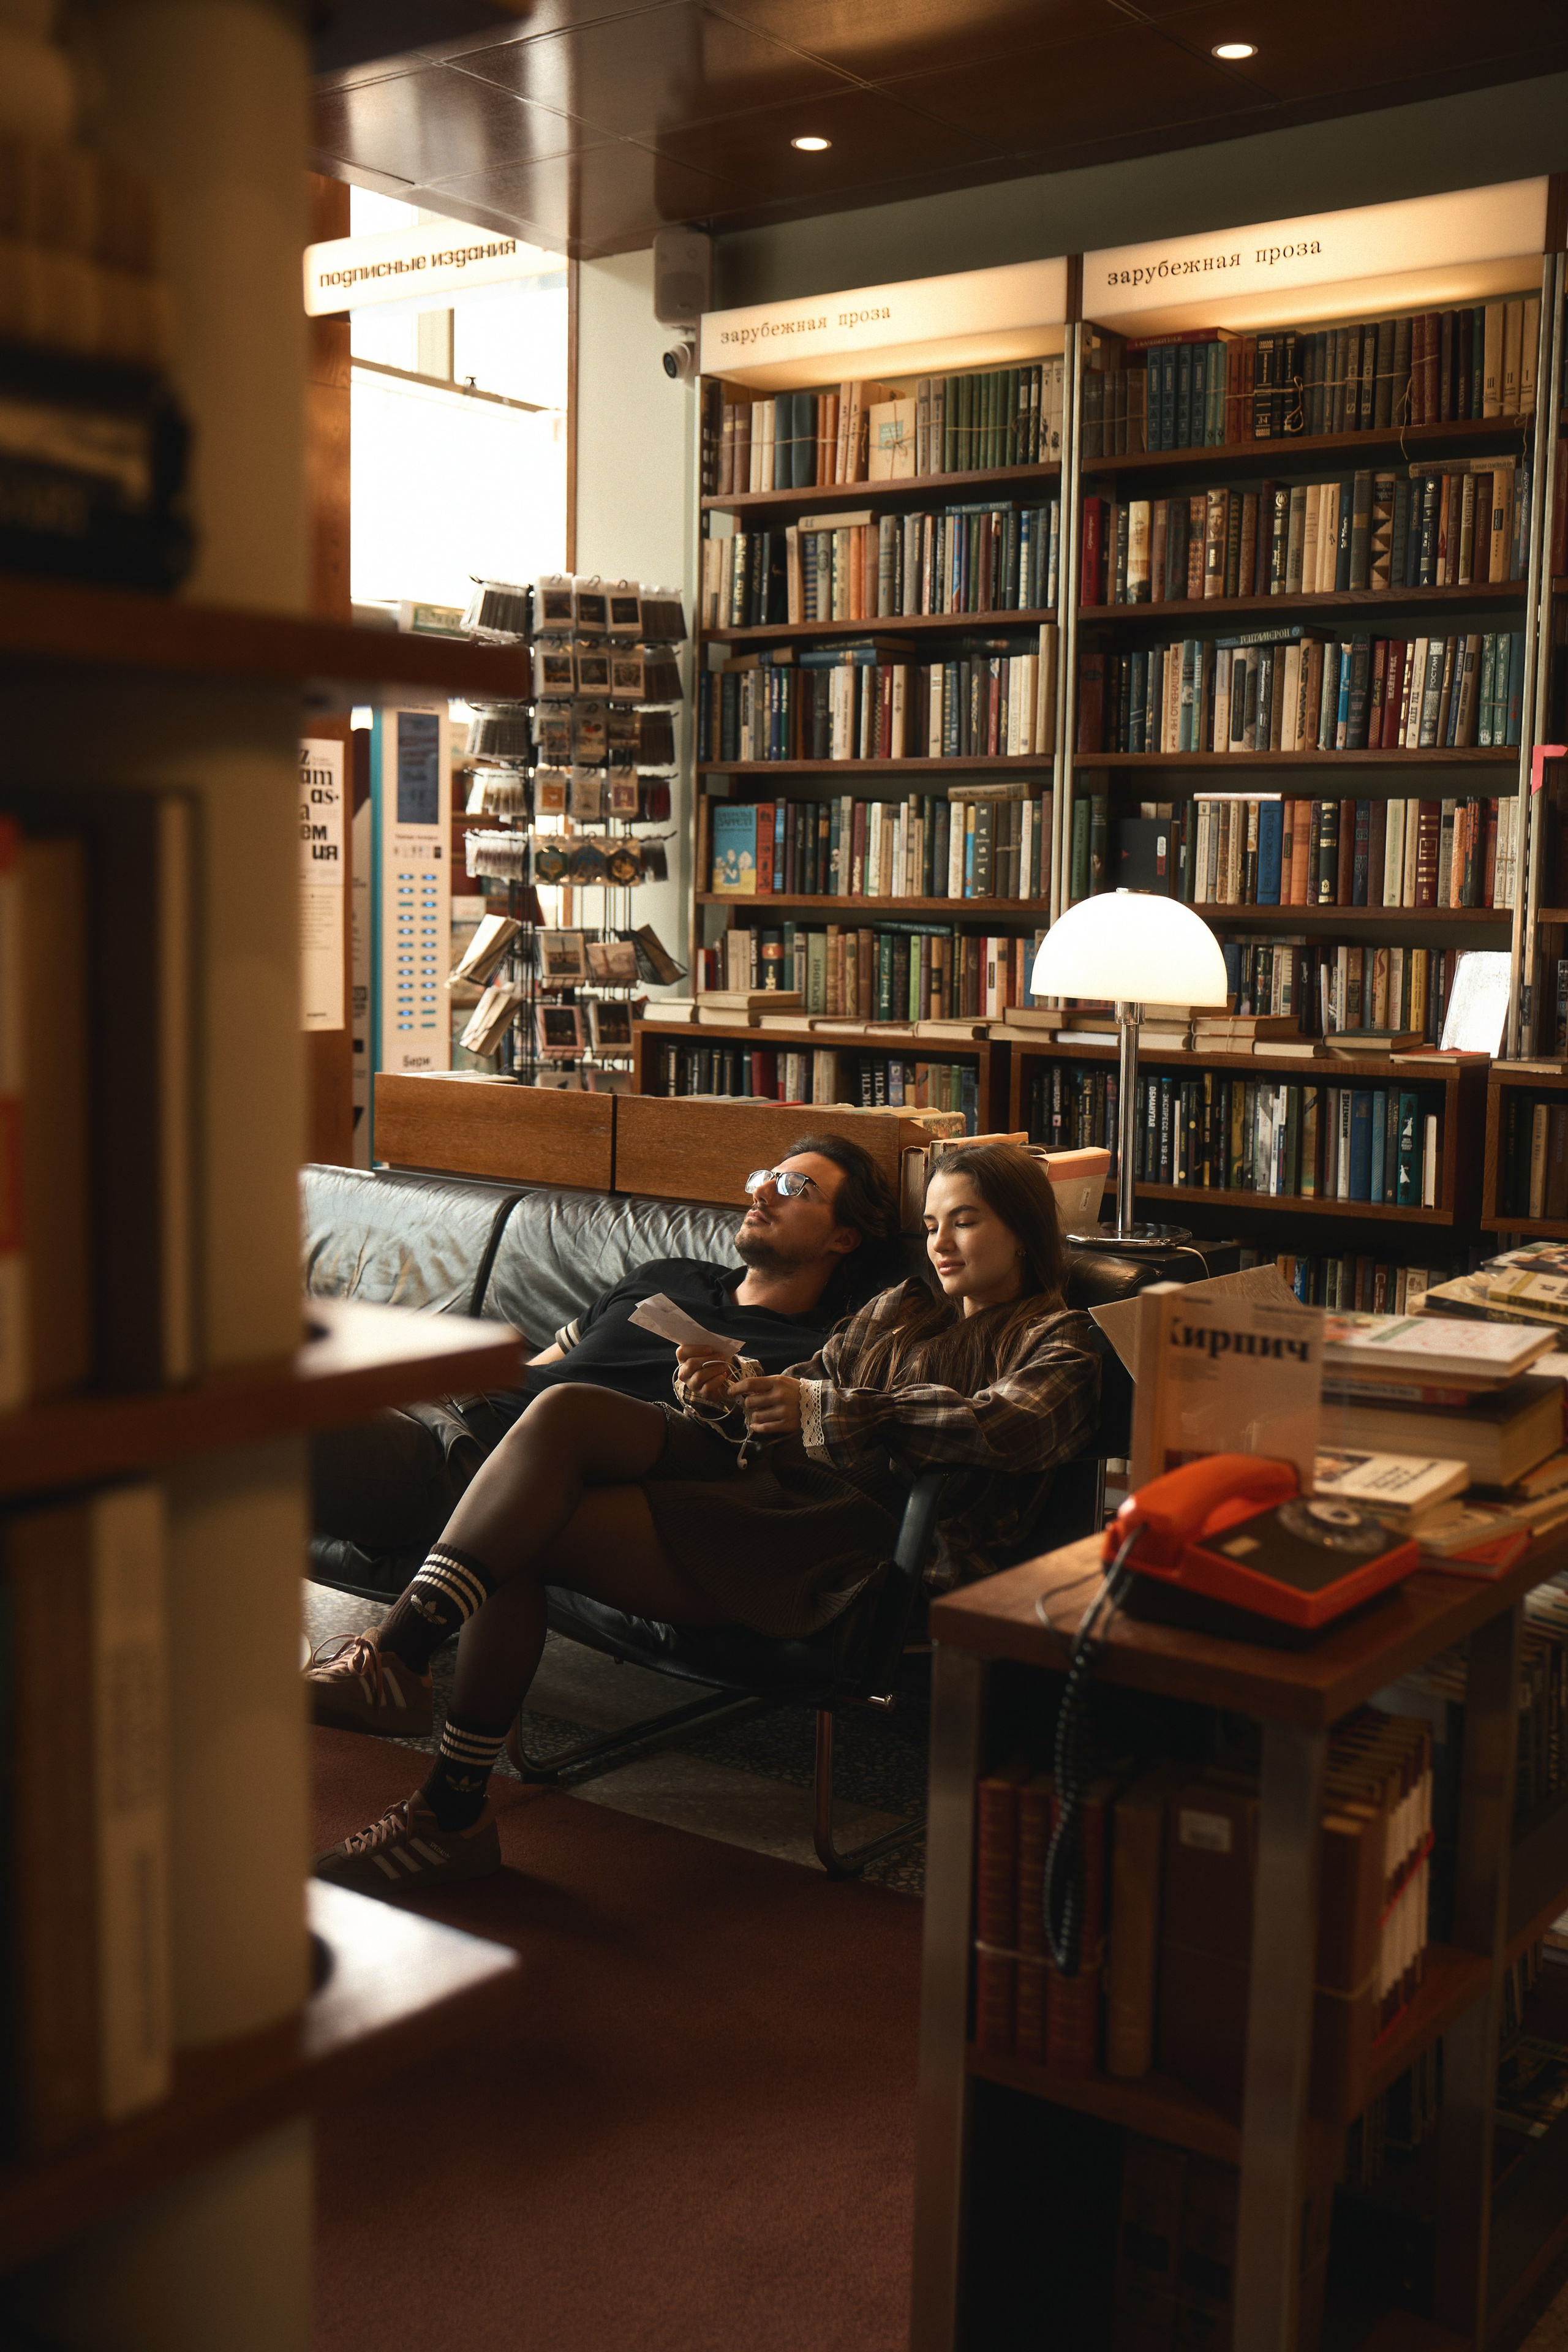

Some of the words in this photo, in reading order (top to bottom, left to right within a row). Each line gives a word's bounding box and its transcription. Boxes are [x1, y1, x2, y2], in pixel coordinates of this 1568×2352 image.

[320, 255, 426, 288] подписные
[431, 238, 516, 268] издания
[1107, 251, 1241, 287] зарубежная
[1255, 239, 1322, 265] проза
[720, 315, 827, 345] зарубежная
[838, 306, 892, 330] проза
[1463, 477, 1474, 494] Рая
[1462, 496, 1473, 527] Книга
[1170, 662, 1179, 715] ОТЧЕНАШЕК
[1430, 655, 1438, 687] РОСТАН
[1169, 718, 1178, 730] ЯН
[1147, 1085, 1156, 1128] ОБМАНУТАЯ
[1341, 1093, 1350, 1138] ДЕТЕКТИВ
[1161, 1133, 1168, 1142] НА
